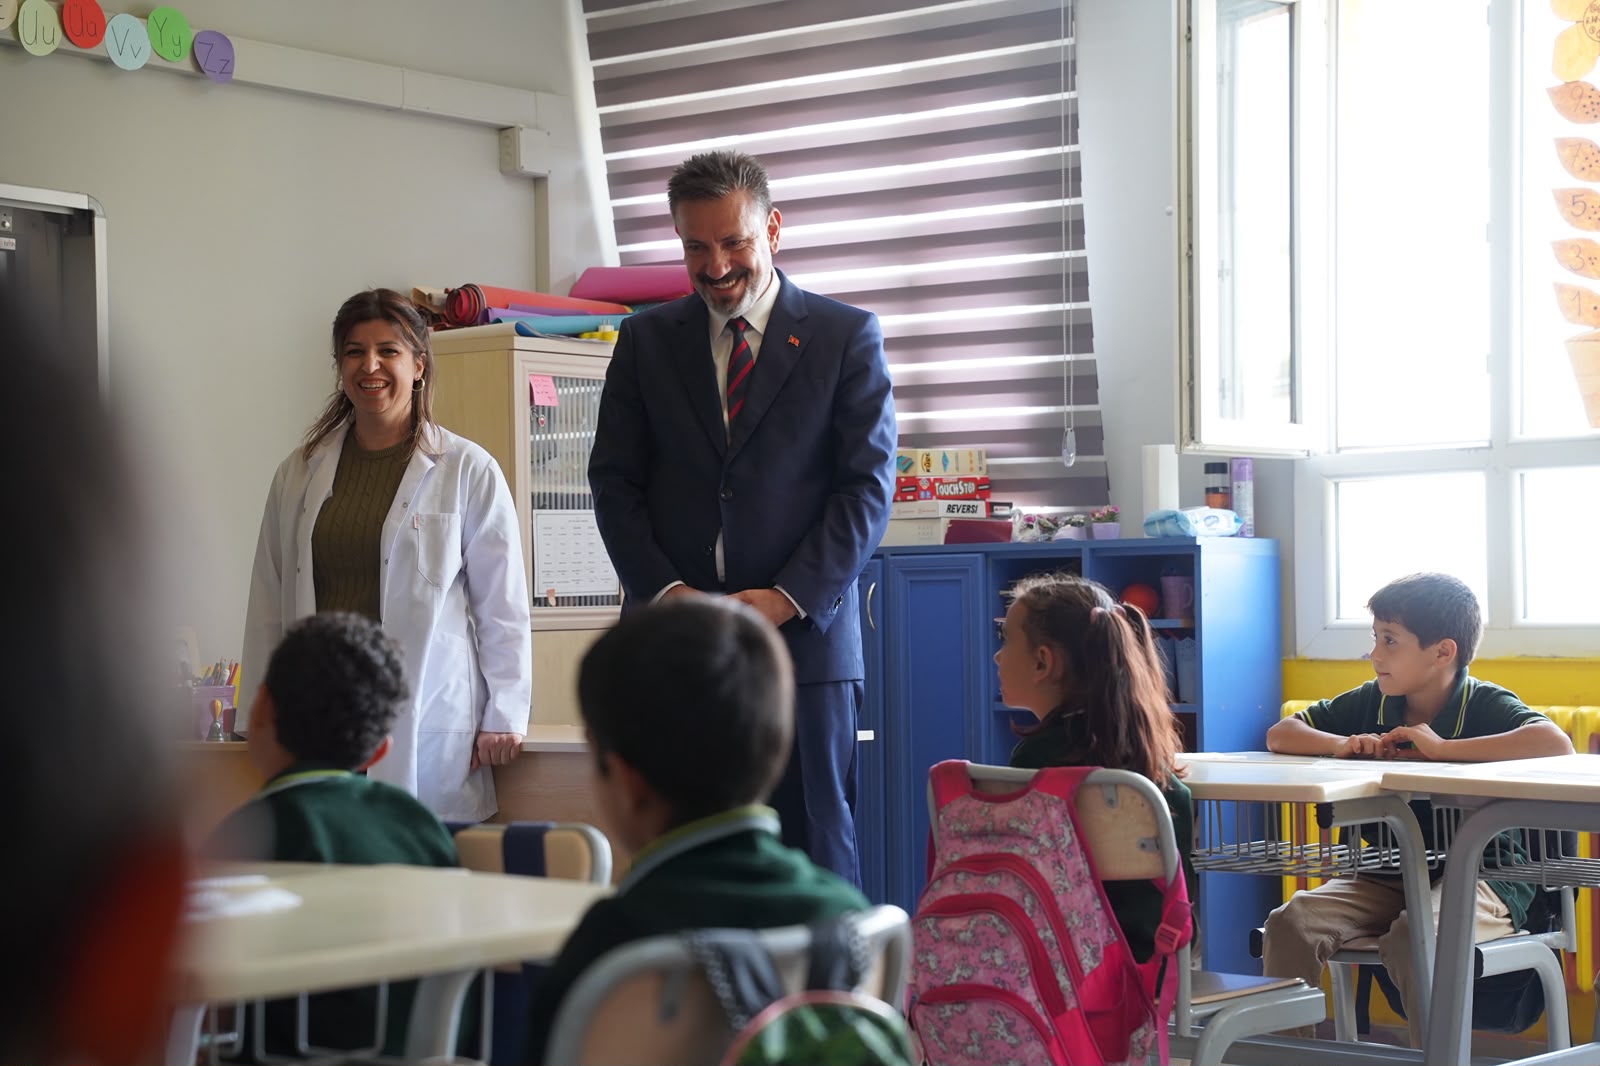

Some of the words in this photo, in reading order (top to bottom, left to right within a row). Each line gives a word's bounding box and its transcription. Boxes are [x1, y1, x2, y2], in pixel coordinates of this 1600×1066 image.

[23, 10, 55, 46] Uu
[111, 25, 142, 59] Vv
[153, 15, 182, 58] Yy
[198, 41, 233, 75] Zz
[1570, 85, 1585, 113] 9
[1568, 142, 1582, 167] 7
[1571, 194, 1587, 217] 5
[1569, 244, 1585, 271] 3
[1571, 289, 1582, 317] 1
[946, 504, 978, 514] REVERSI
